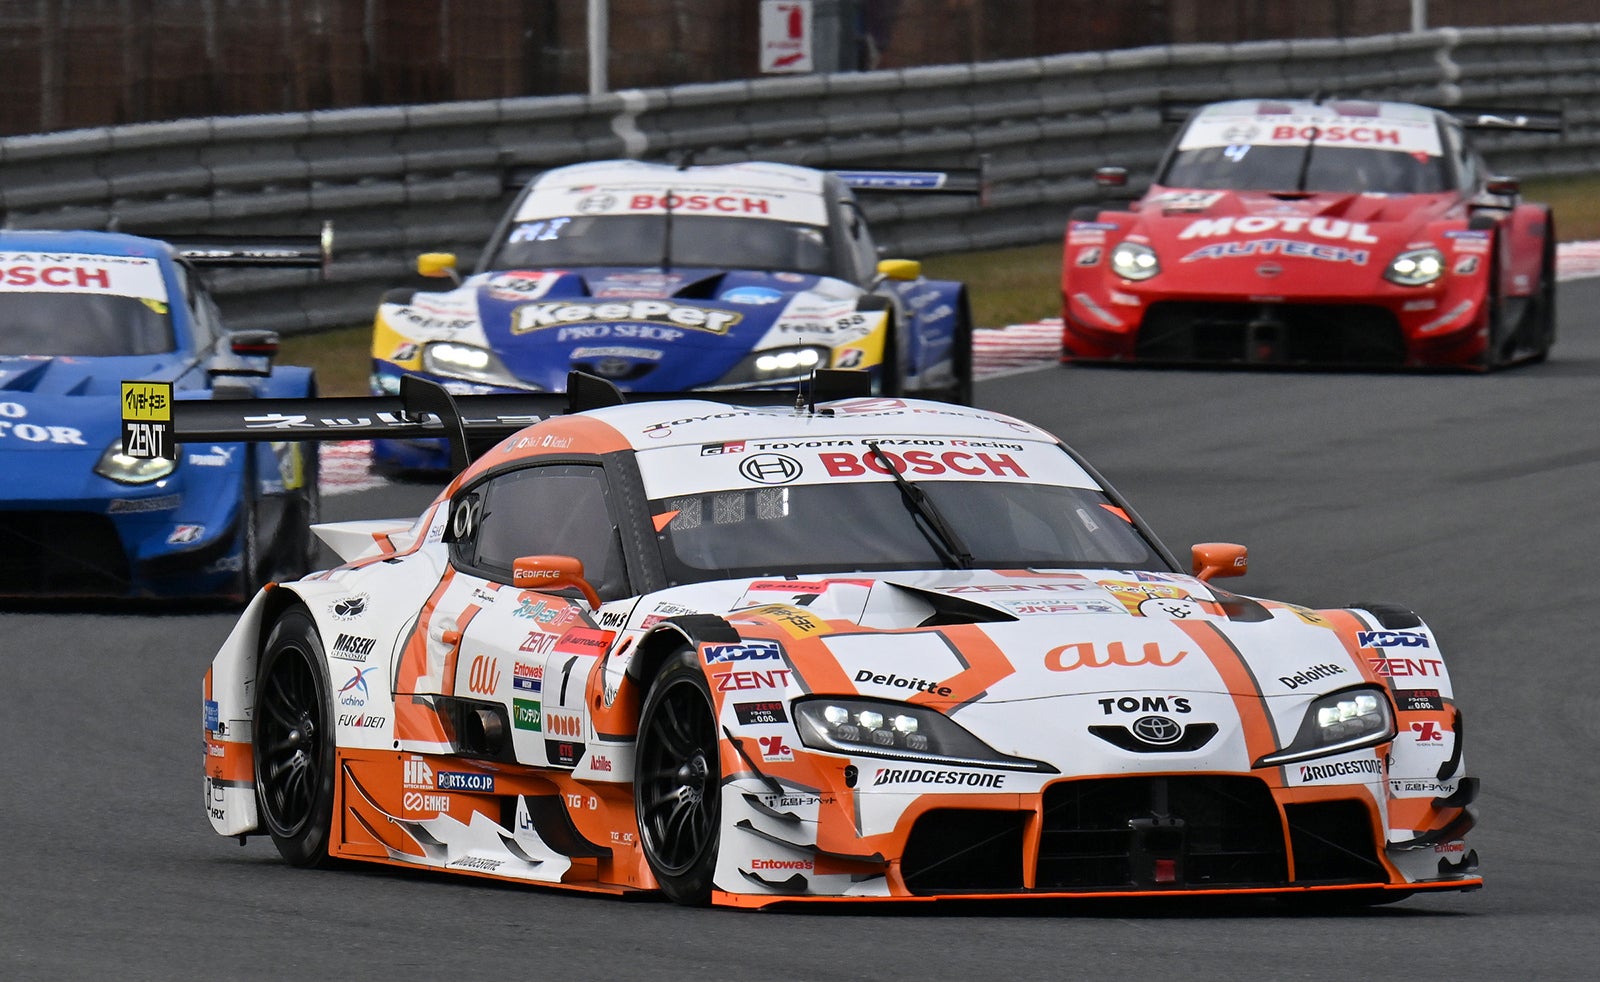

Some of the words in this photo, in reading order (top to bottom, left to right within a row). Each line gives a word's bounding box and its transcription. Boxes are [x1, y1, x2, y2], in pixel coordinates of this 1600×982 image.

[1271, 126, 1400, 144] BOSCH
[628, 195, 769, 213] BOSCH
[1177, 216, 1379, 244] MOTUL
[1179, 238, 1370, 265] AUTECH
[0, 266, 109, 289] SCH
[516, 300, 736, 332] KeePer
[557, 326, 610, 341] PRO
[614, 326, 685, 341] SHOP
[127, 423, 166, 457] ZENT
[702, 442, 745, 456] GR
[754, 440, 853, 450] TOYOTA
[861, 439, 944, 447] GAZOO
[950, 440, 1024, 451] Racing
[818, 450, 1030, 478] BOSCH
[523, 570, 560, 578] EDIFICE
[934, 584, 1087, 593] ZENT
[598, 612, 627, 627] TOM'S
[333, 633, 377, 655] MASEKI
[519, 631, 559, 654] ZENT
[1358, 631, 1430, 648] KDDI
[704, 644, 781, 665] KDDI
[1044, 641, 1188, 672] au
[469, 655, 501, 695] au
[514, 662, 543, 678] Entowa's
[1369, 658, 1442, 677] ZENT
[560, 656, 579, 706] 1
[714, 670, 792, 691] ZENT
[341, 694, 365, 707] uchino
[1098, 695, 1192, 714] TOM'S
[338, 712, 386, 728] FUKADEN
[547, 714, 580, 737] PONOS
[591, 755, 612, 772] Achilles
[1300, 759, 1382, 782] BRIDGESTONE
[873, 768, 1006, 788] BRIDGESTONE
[1405, 783, 1455, 792] 広島トヨペット
[424, 795, 449, 812] ENKEI
[781, 797, 837, 807] 広島トヨペット
[211, 808, 225, 821] HRX
[751, 858, 814, 870] Entowa's
